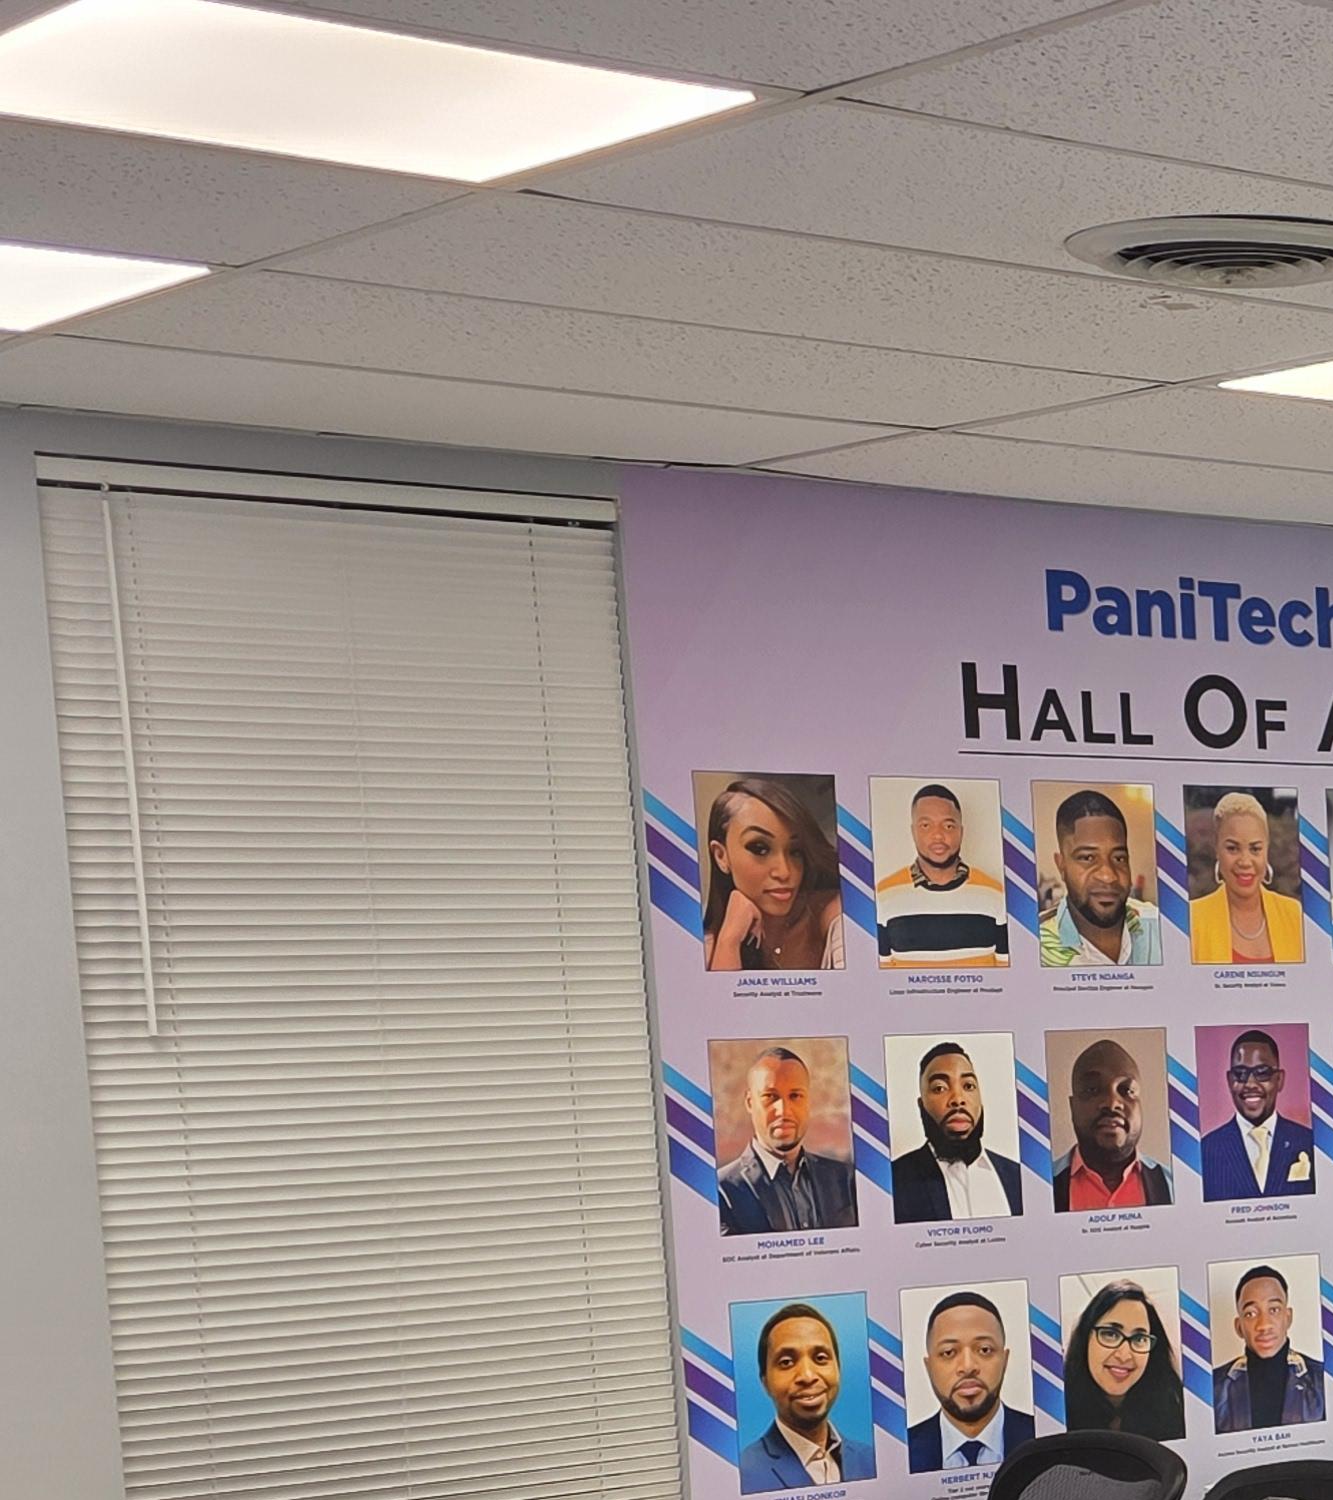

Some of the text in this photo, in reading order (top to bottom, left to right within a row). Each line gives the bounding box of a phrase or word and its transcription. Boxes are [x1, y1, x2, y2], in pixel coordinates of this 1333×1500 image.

[737, 977, 817, 987] JANAE WILLIAMS
[908, 975, 983, 983] NARCISSE FOTSO
[1071, 973, 1097, 981] STEVE
[1231, 1203, 1290, 1214] FRED JOHNSON
[1088, 1214, 1116, 1223] ADOLF
[927, 1225, 993, 1237] VICTOR FLOMO
[757, 1236, 825, 1249] MOHAMED LEE
[737, 1254, 760, 1262] Analyst
[768, 1251, 804, 1259] Department
[941, 1472, 980, 1485] HERBERT
